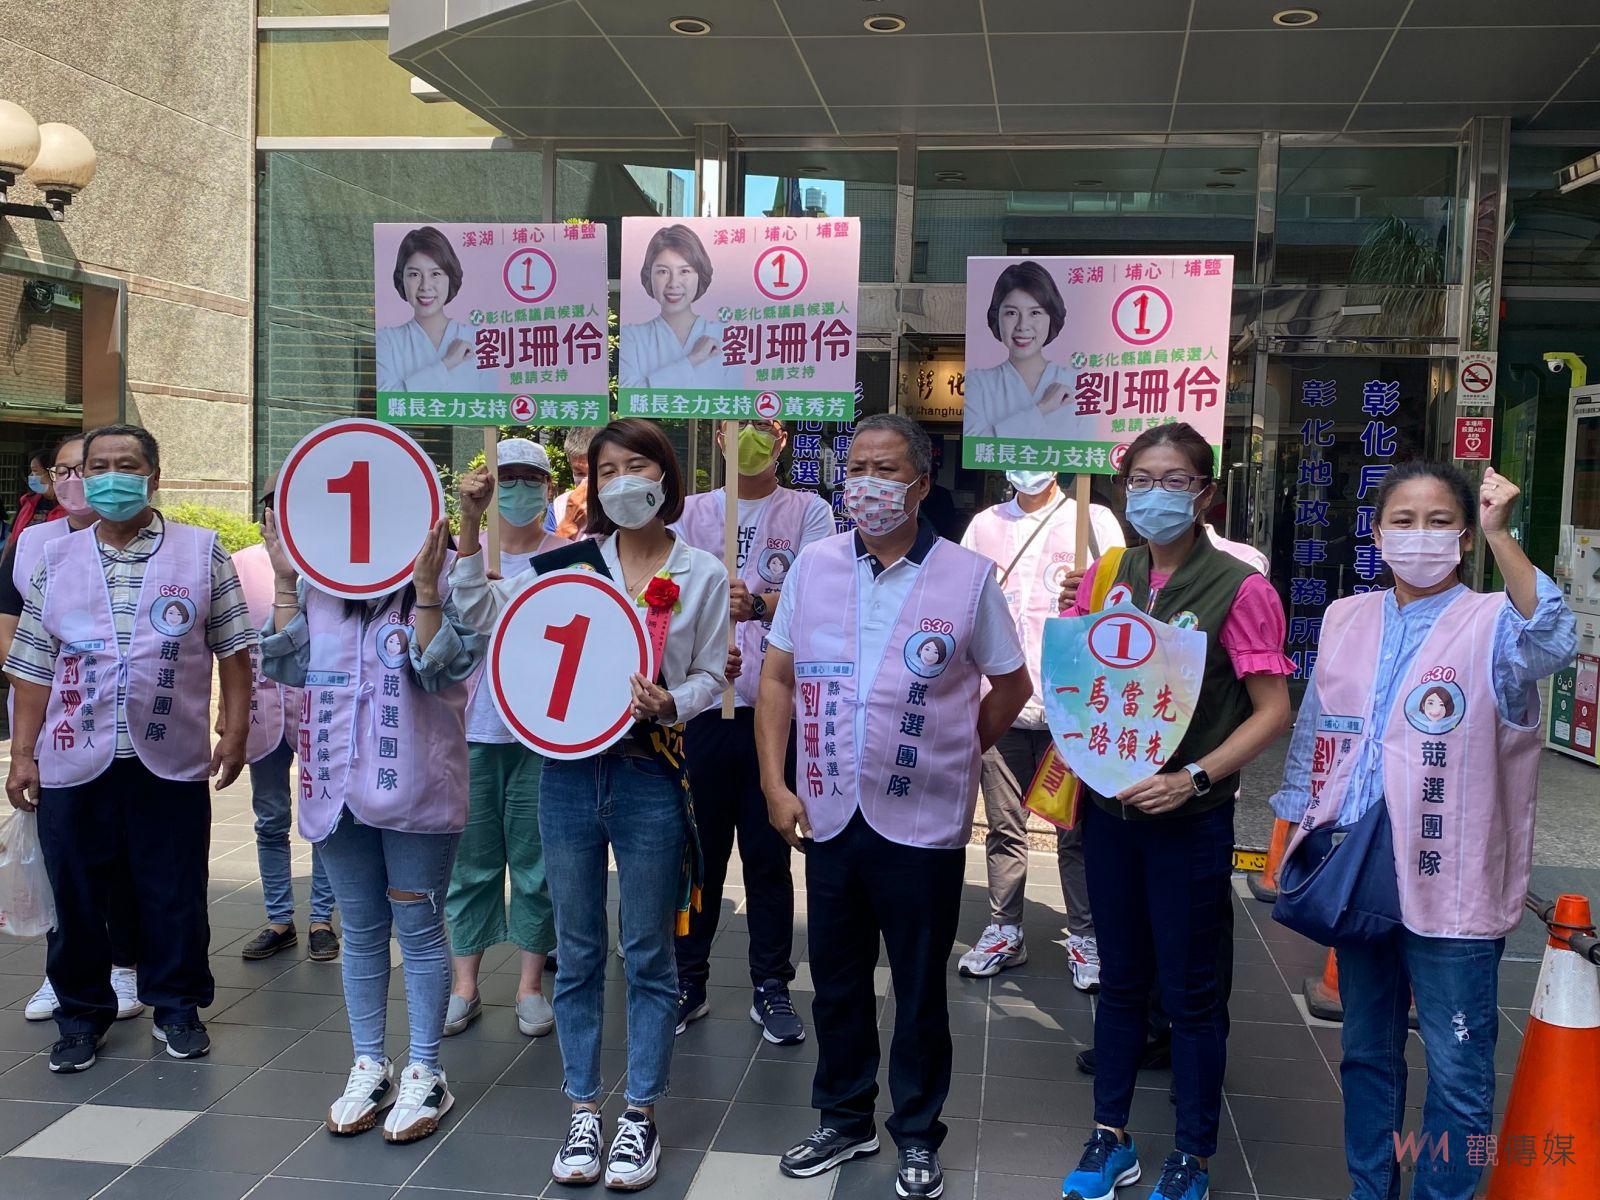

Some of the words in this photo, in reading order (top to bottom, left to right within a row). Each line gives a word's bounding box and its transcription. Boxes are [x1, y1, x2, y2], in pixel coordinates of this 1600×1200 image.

[463, 231, 494, 247] 溪湖
[512, 228, 545, 243] 埔心
[564, 223, 596, 240] 埔鹽
[713, 228, 746, 245] 溪湖
[765, 225, 797, 242] 埔心
[816, 222, 849, 238] 埔鹽
[521, 256, 535, 291] 1
[771, 253, 790, 287] 1
[1067, 266, 1104, 285] 溪湖
[1124, 262, 1162, 281] 埔心
[1184, 258, 1222, 277] 埔鹽
[486, 303, 600, 324] 彰化縣議員候選人
[733, 300, 849, 321] 彰化縣議員候選人
[1133, 293, 1151, 335] 1
[475, 321, 603, 370] 劉珊伶
[721, 318, 853, 366] 劉珊伶
[1088, 346, 1218, 368] 彰化縣議員候選人
[510, 368, 569, 386] 懇請支持
[756, 365, 816, 383] 懇請支持
[1074, 365, 1221, 416] 劉珊伶
[388, 397, 507, 419] 縣長全力支持
[539, 399, 600, 421] 黃秀芳
[629, 395, 751, 415] 縣長全力支持
[785, 397, 846, 418] 黃秀芳
[917, 406, 963, 417] hanghu
[974, 443, 1106, 468] 縣長全力支持
[327, 461, 371, 564] 1
[1288, 379, 1337, 645] 彰化地政事務所
[767, 538, 791, 551] 630
[1052, 552, 1074, 563] 630
[159, 584, 189, 599] 630
[920, 618, 953, 635] 630
[1104, 622, 1140, 661] 1
[543, 613, 591, 723] 1
[1420, 666, 1456, 684] 630
[144, 640, 181, 743] 競選團隊
[1055, 676, 1177, 723] 一馬當先
[317, 690, 334, 800] 縣議員候選人
[377, 674, 401, 791] 競選團隊
[801, 681, 824, 798] 劉珊伶
[825, 681, 844, 797] 縣議員候選人
[886, 681, 929, 797] 競選團隊
[1062, 725, 1166, 766] 一路領先
[1418, 740, 1448, 876] 競選團隊
